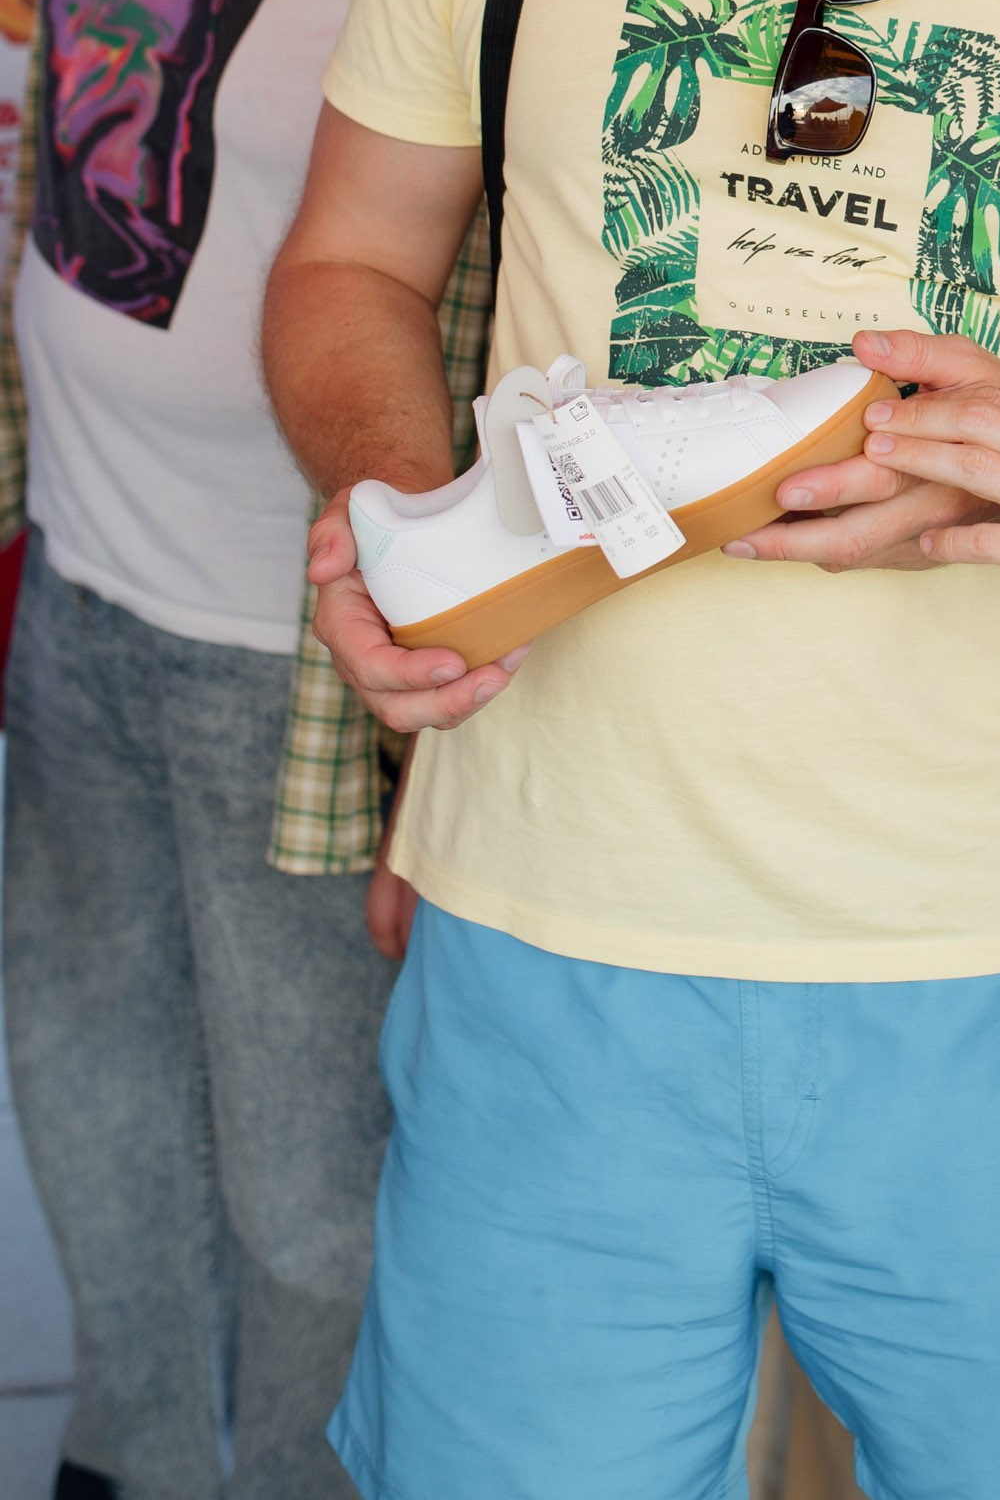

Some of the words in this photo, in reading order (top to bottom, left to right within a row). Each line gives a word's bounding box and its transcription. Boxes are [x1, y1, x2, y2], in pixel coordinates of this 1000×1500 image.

[852, 164, 886, 178] AND
[719, 170, 898, 232] TRAVEL
[727, 228, 776, 265] help
[784, 247, 814, 257] us
[822, 247, 886, 270] find
[729, 302, 879, 322] OURSELVES
[583, 428, 597, 440] 2.0
